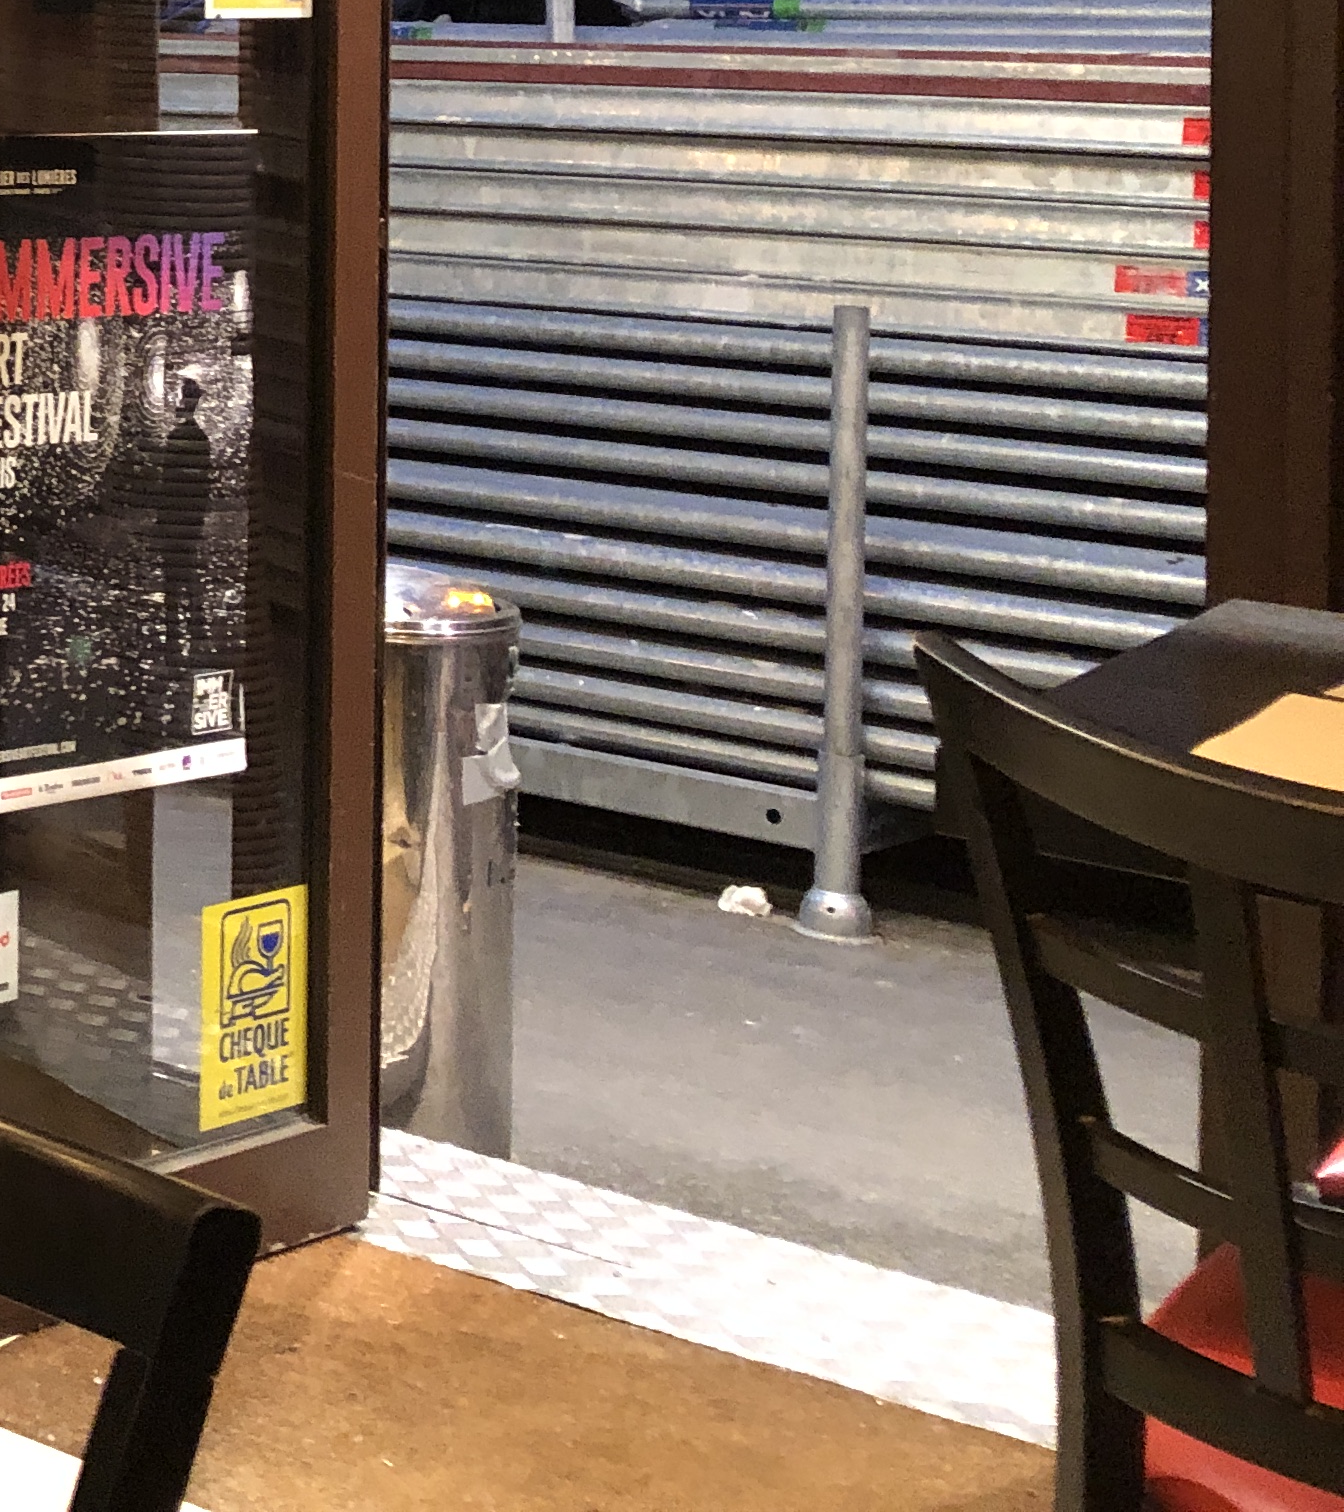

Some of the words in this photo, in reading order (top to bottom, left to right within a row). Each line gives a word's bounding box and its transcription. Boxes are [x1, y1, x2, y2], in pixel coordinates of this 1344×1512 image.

[2, 593, 16, 612] 24
[194, 708, 229, 730] SIVE
[219, 1017, 289, 1063] CHEQUE
[234, 1054, 289, 1094] TABLE
